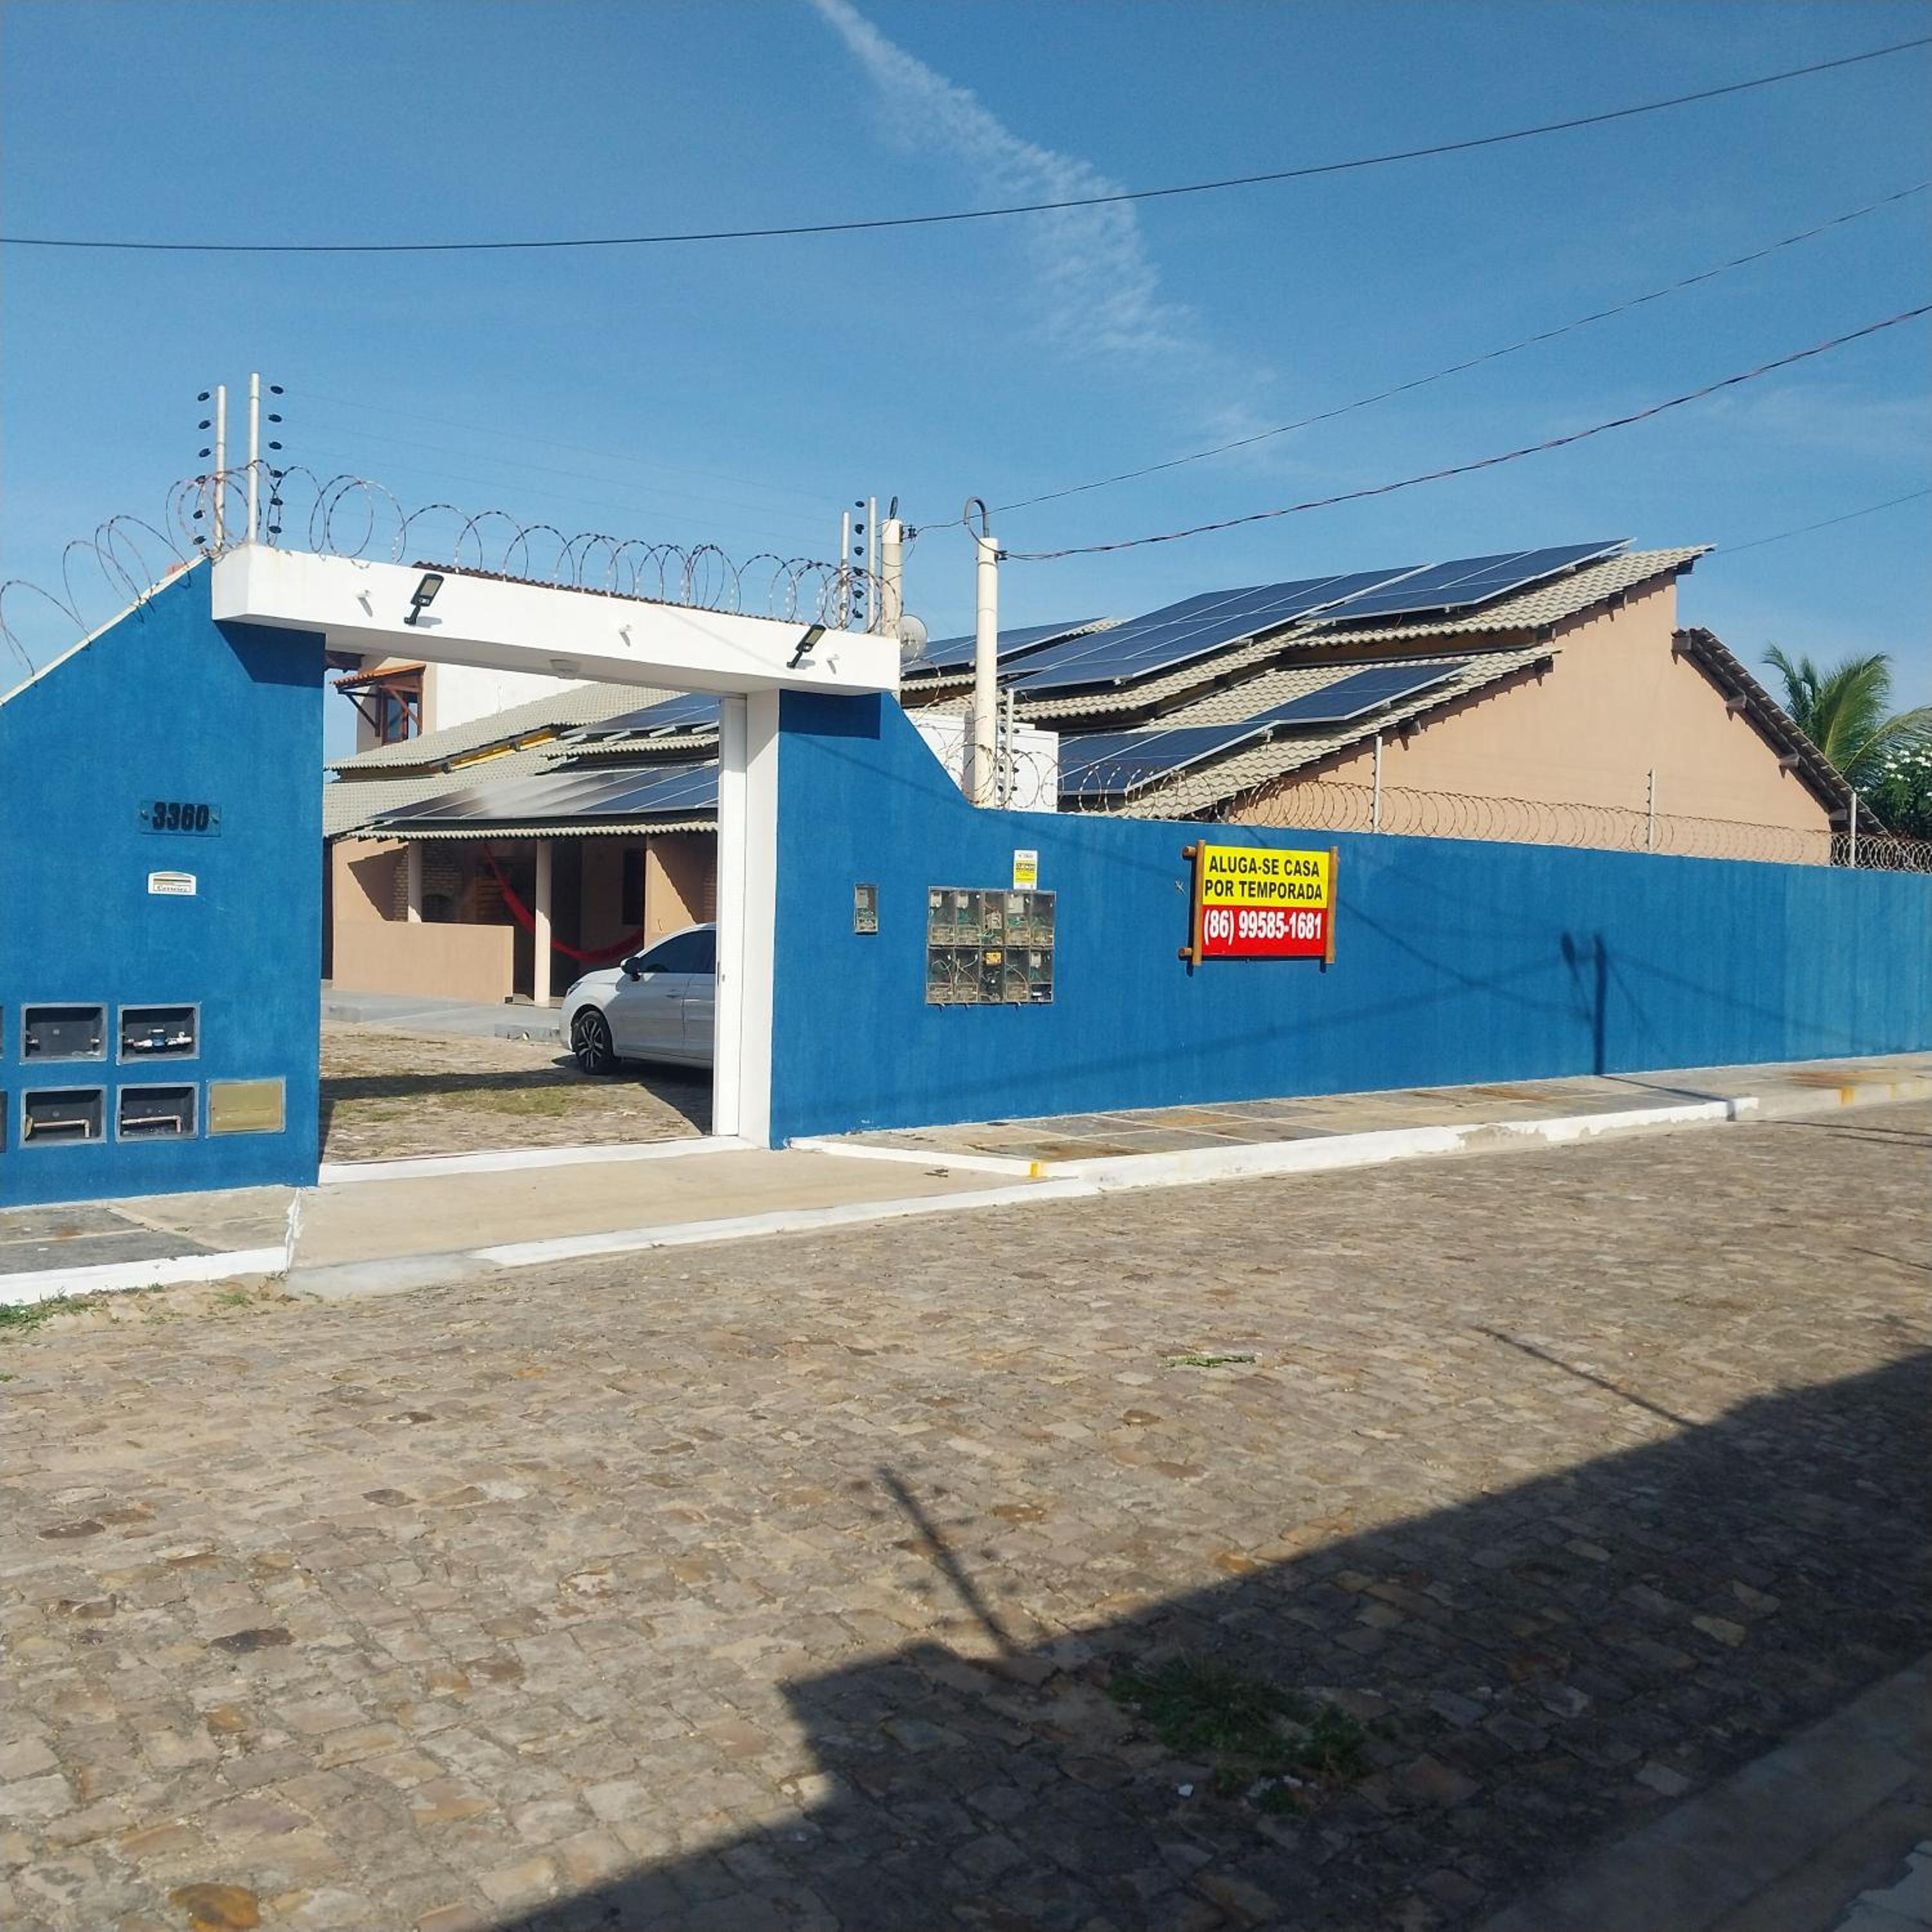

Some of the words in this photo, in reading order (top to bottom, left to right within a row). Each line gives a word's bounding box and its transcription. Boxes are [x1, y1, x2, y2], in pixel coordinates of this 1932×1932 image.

[152, 802, 209, 831] 3360
[1209, 855, 1280, 875] ALUGA-SE
[1284, 858, 1320, 878] CASA
[1204, 880, 1234, 897] POR
[1238, 880, 1322, 900] TEMPORADA
[1204, 909, 1235, 945] (86)
[1238, 910, 1321, 940] 99585-1681
